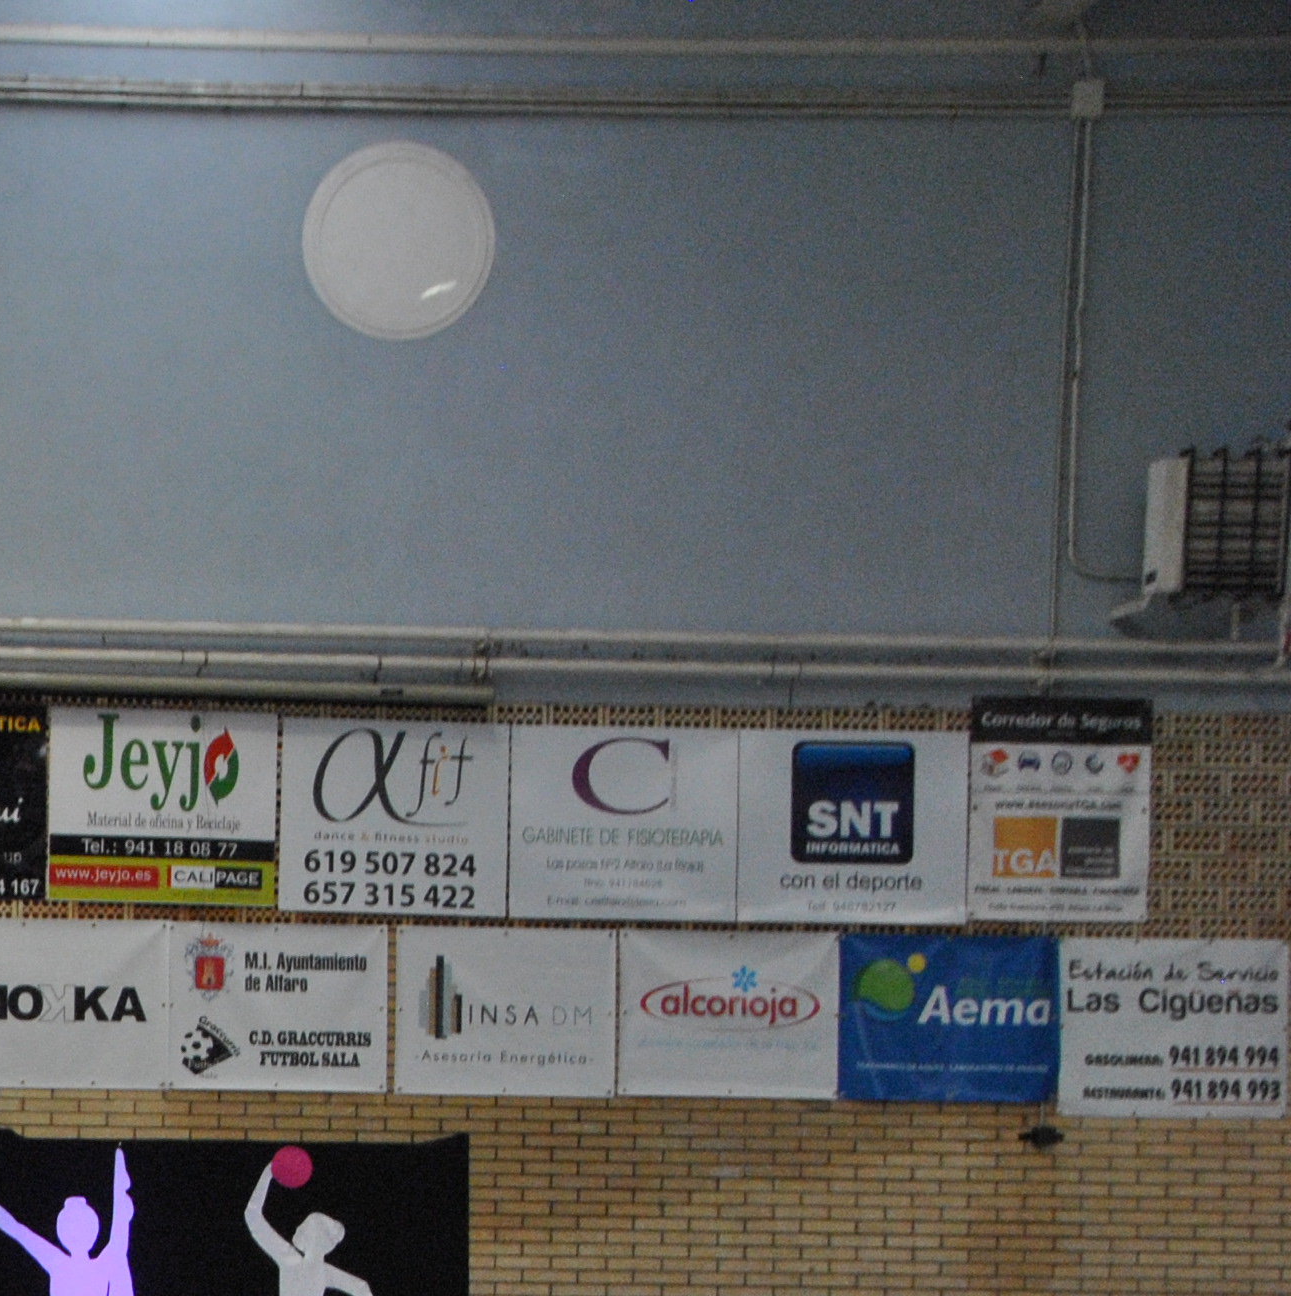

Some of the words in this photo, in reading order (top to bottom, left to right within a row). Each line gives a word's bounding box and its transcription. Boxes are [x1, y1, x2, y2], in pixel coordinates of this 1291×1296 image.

[1082, 713, 1141, 732] Seguros
[87, 811, 131, 827] Material
[134, 812, 147, 826] de
[150, 813, 183, 828] oficina
[186, 818, 193, 831] y
[196, 815, 240, 833] Reciclaje
[806, 801, 899, 838] SNT
[82, 838, 117, 854] Tel.:
[125, 840, 154, 854] 941
[165, 841, 184, 855] 18
[190, 842, 211, 857] 08
[219, 842, 238, 857] 77
[314, 831, 355, 841] dance
[374, 832, 419, 843] fitness
[522, 826, 594, 845] GABINETE
[599, 828, 619, 845] DE
[628, 829, 723, 847] FISIOTERAPIA
[806, 842, 900, 854] INFORMATICA
[304, 850, 356, 873] 619
[365, 851, 415, 875] 507
[424, 853, 476, 877] 824
[995, 848, 1056, 873] TGA
[55, 867, 151, 882] www.jeyjo.es
[780, 873, 815, 890] con
[823, 872, 839, 889] el
[847, 872, 922, 893] deporte
[11, 878, 39, 895] 167
[304, 881, 355, 905] 657
[365, 882, 415, 907] 315
[424, 884, 475, 909] 422
[245, 951, 272, 970] M.I.
[276, 951, 367, 973] Ayuntamiento
[1069, 959, 1153, 981] Estación
[1164, 962, 1188, 981] de
[1197, 961, 1279, 982] Servicio
[245, 974, 260, 992] de
[265, 974, 308, 992] Alfaro
[660, 984, 797, 1024] alcorioja
[917, 985, 1051, 1026] Aema
[1067, 987, 1120, 1013] Las
[1138, 987, 1279, 1020] Cigüeñas
[469, 1004, 539, 1026] INSA
[552, 1005, 592, 1026] DM
[199, 1015, 241, 1057] Graccurris
[249, 1030, 274, 1046] C.D.
[277, 1031, 371, 1047] GRACCURRIS
[260, 1051, 319, 1067] FUTBOL
[322, 1052, 360, 1067] SALA
[1170, 1045, 1200, 1066] 941
[1205, 1045, 1239, 1067] 894
[1245, 1046, 1280, 1067] 994
[1171, 1079, 1202, 1100] 941
[1207, 1079, 1241, 1100] 894
[1246, 1079, 1281, 1100] 993
